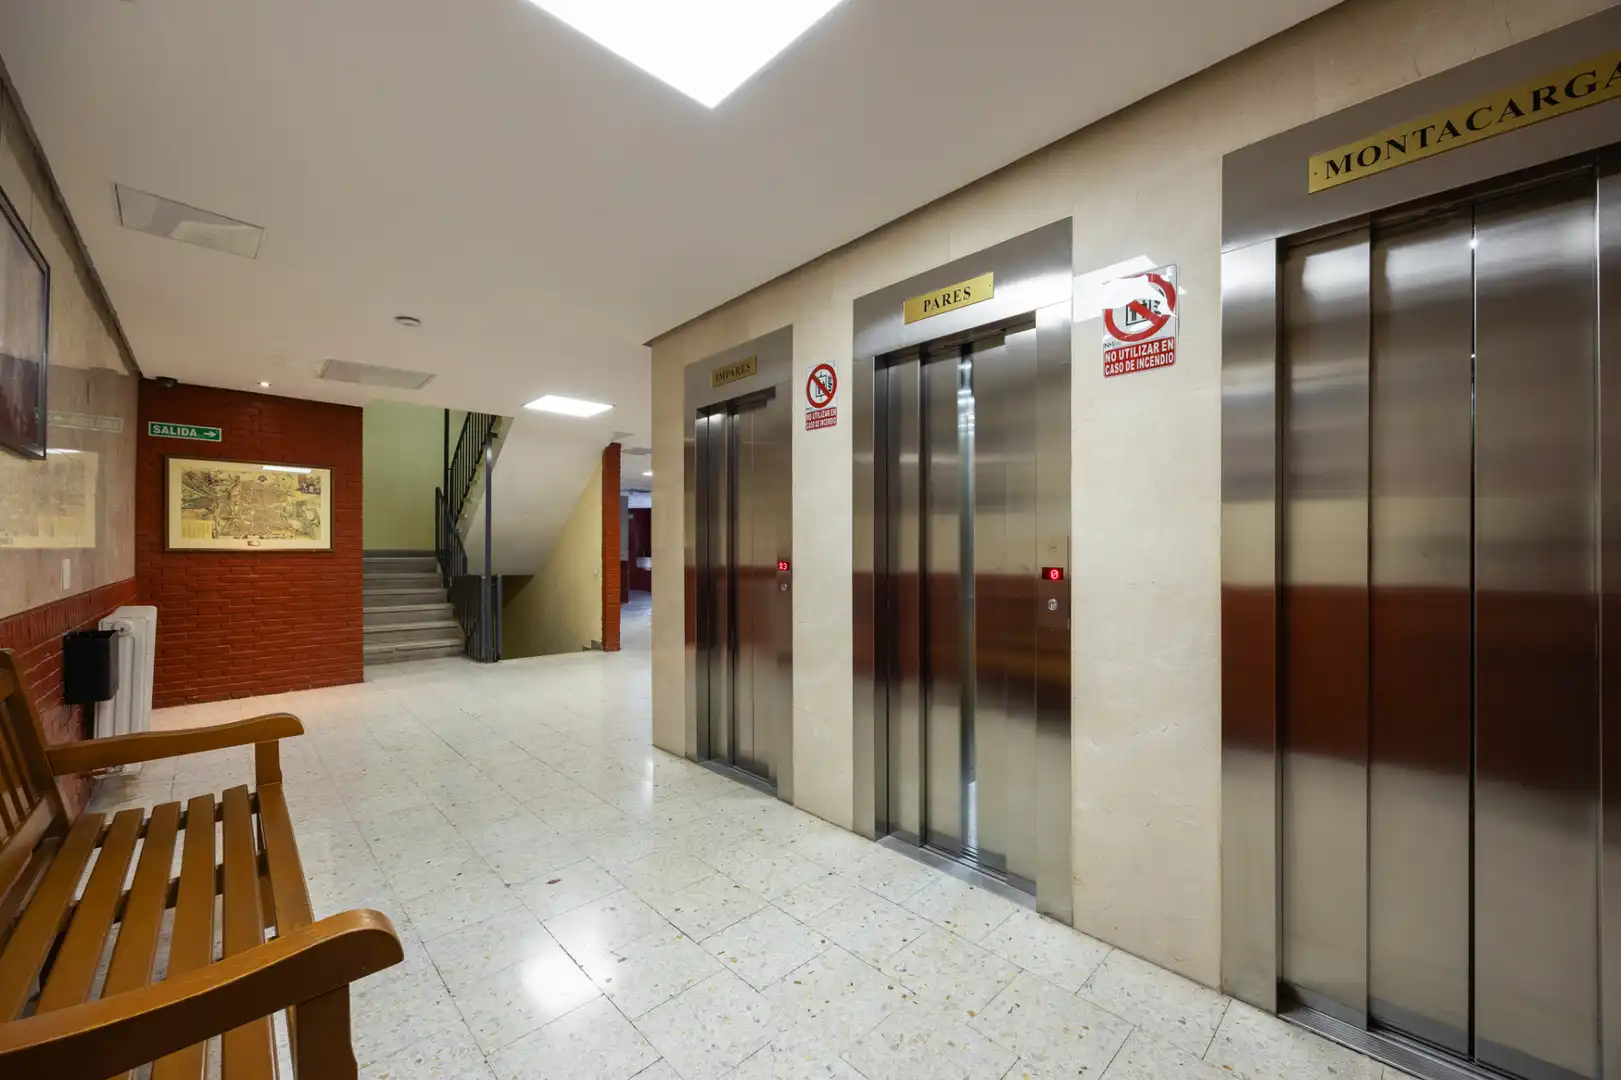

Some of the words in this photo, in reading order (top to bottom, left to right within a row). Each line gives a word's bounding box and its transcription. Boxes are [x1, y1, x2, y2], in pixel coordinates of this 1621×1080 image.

[923, 286, 971, 312] PARES
[1105, 351, 1117, 363] NO
[1119, 341, 1160, 361] UTILIZAR
[1162, 338, 1174, 352] EN
[1105, 362, 1124, 376] CASO
[1126, 359, 1135, 371] DE
[1136, 351, 1174, 369] INCENDIO
[152, 424, 197, 437] SALIDA
